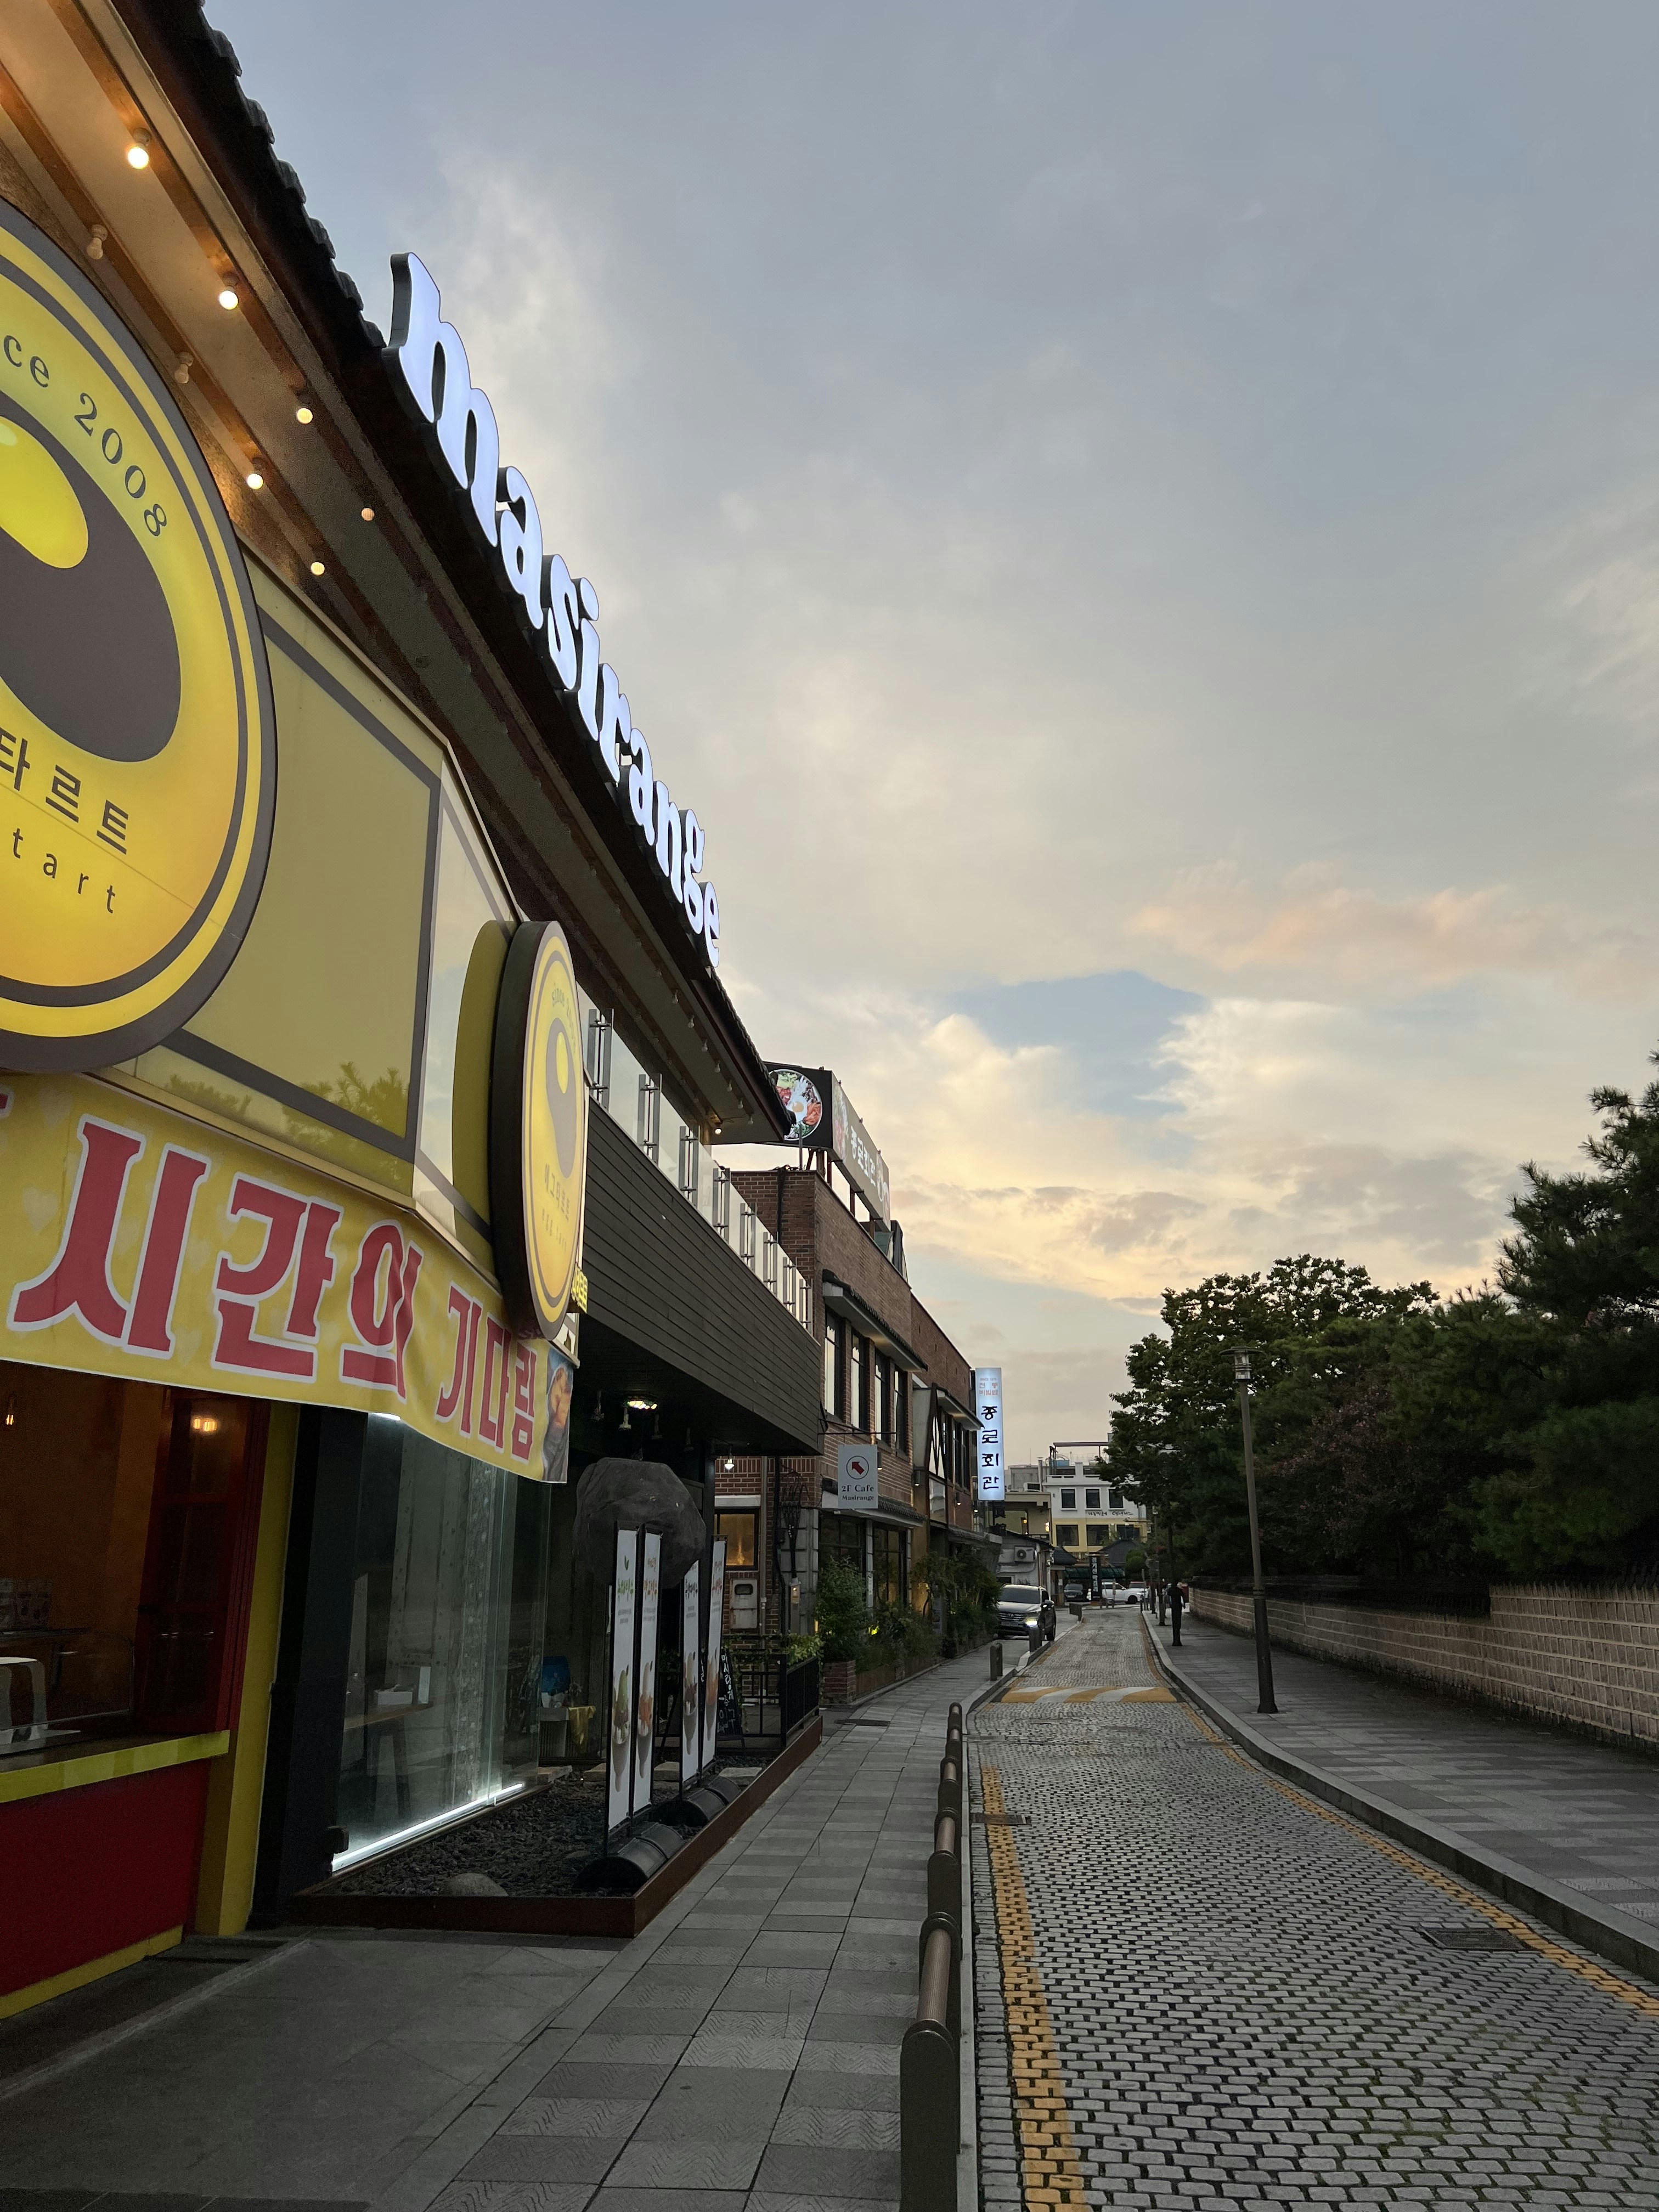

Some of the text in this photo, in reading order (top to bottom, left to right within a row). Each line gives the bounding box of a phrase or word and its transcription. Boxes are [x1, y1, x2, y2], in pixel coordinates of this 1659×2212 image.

[74, 392, 167, 537] 2008
[12, 827, 116, 914] tart
[9, 1114, 538, 1464] 시간의 기다림
